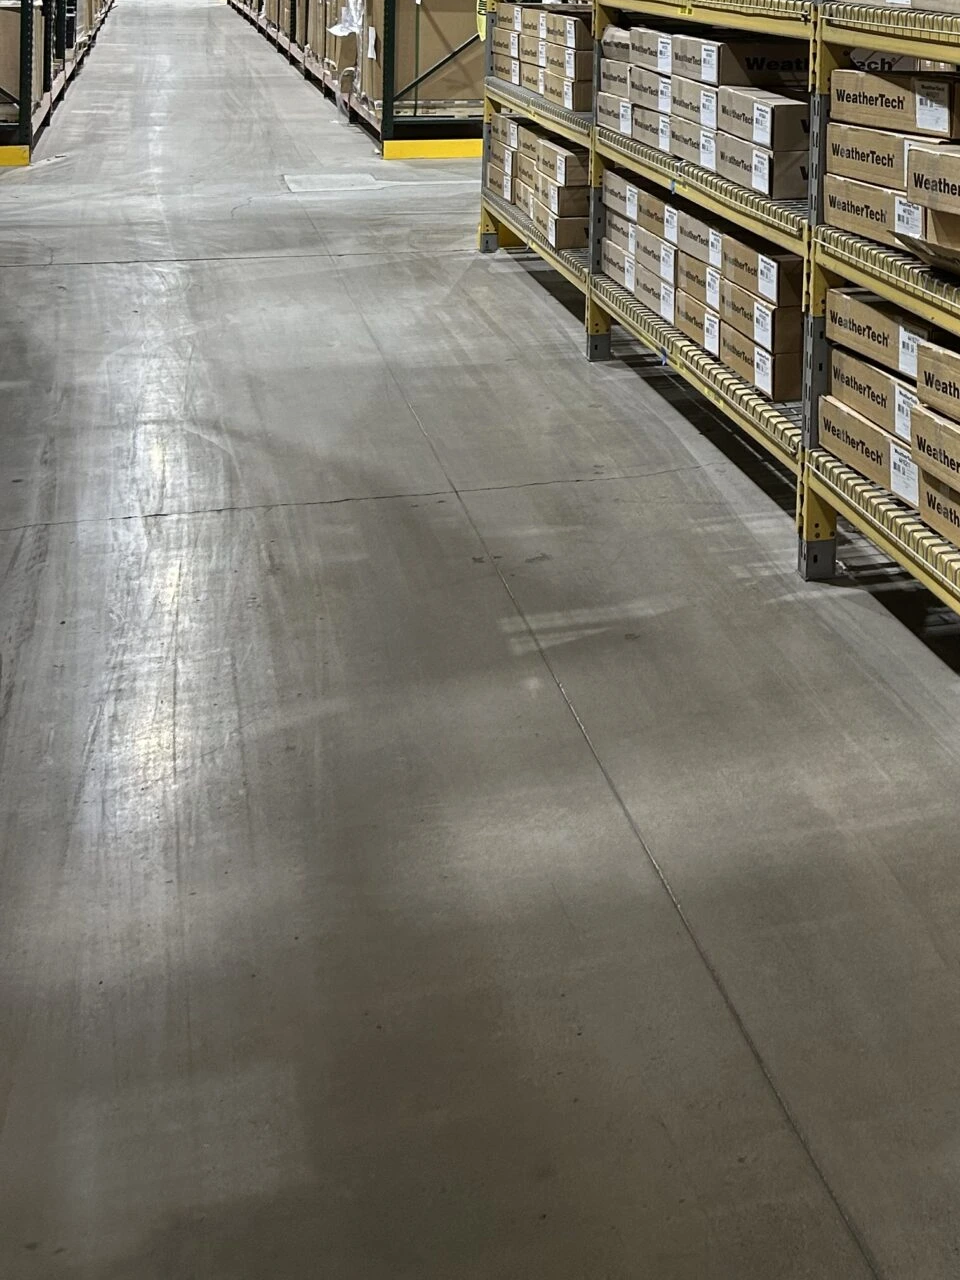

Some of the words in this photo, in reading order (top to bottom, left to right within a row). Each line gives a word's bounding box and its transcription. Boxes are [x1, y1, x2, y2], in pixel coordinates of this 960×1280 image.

[836, 88, 904, 110] WeatherTech
[832, 144, 894, 168] WeatherTech
[829, 195, 886, 222] WeatherTech
[830, 310, 888, 348] WeatherTech
[833, 367, 887, 408] WeatherTech
[823, 417, 883, 466] WeatherTech
